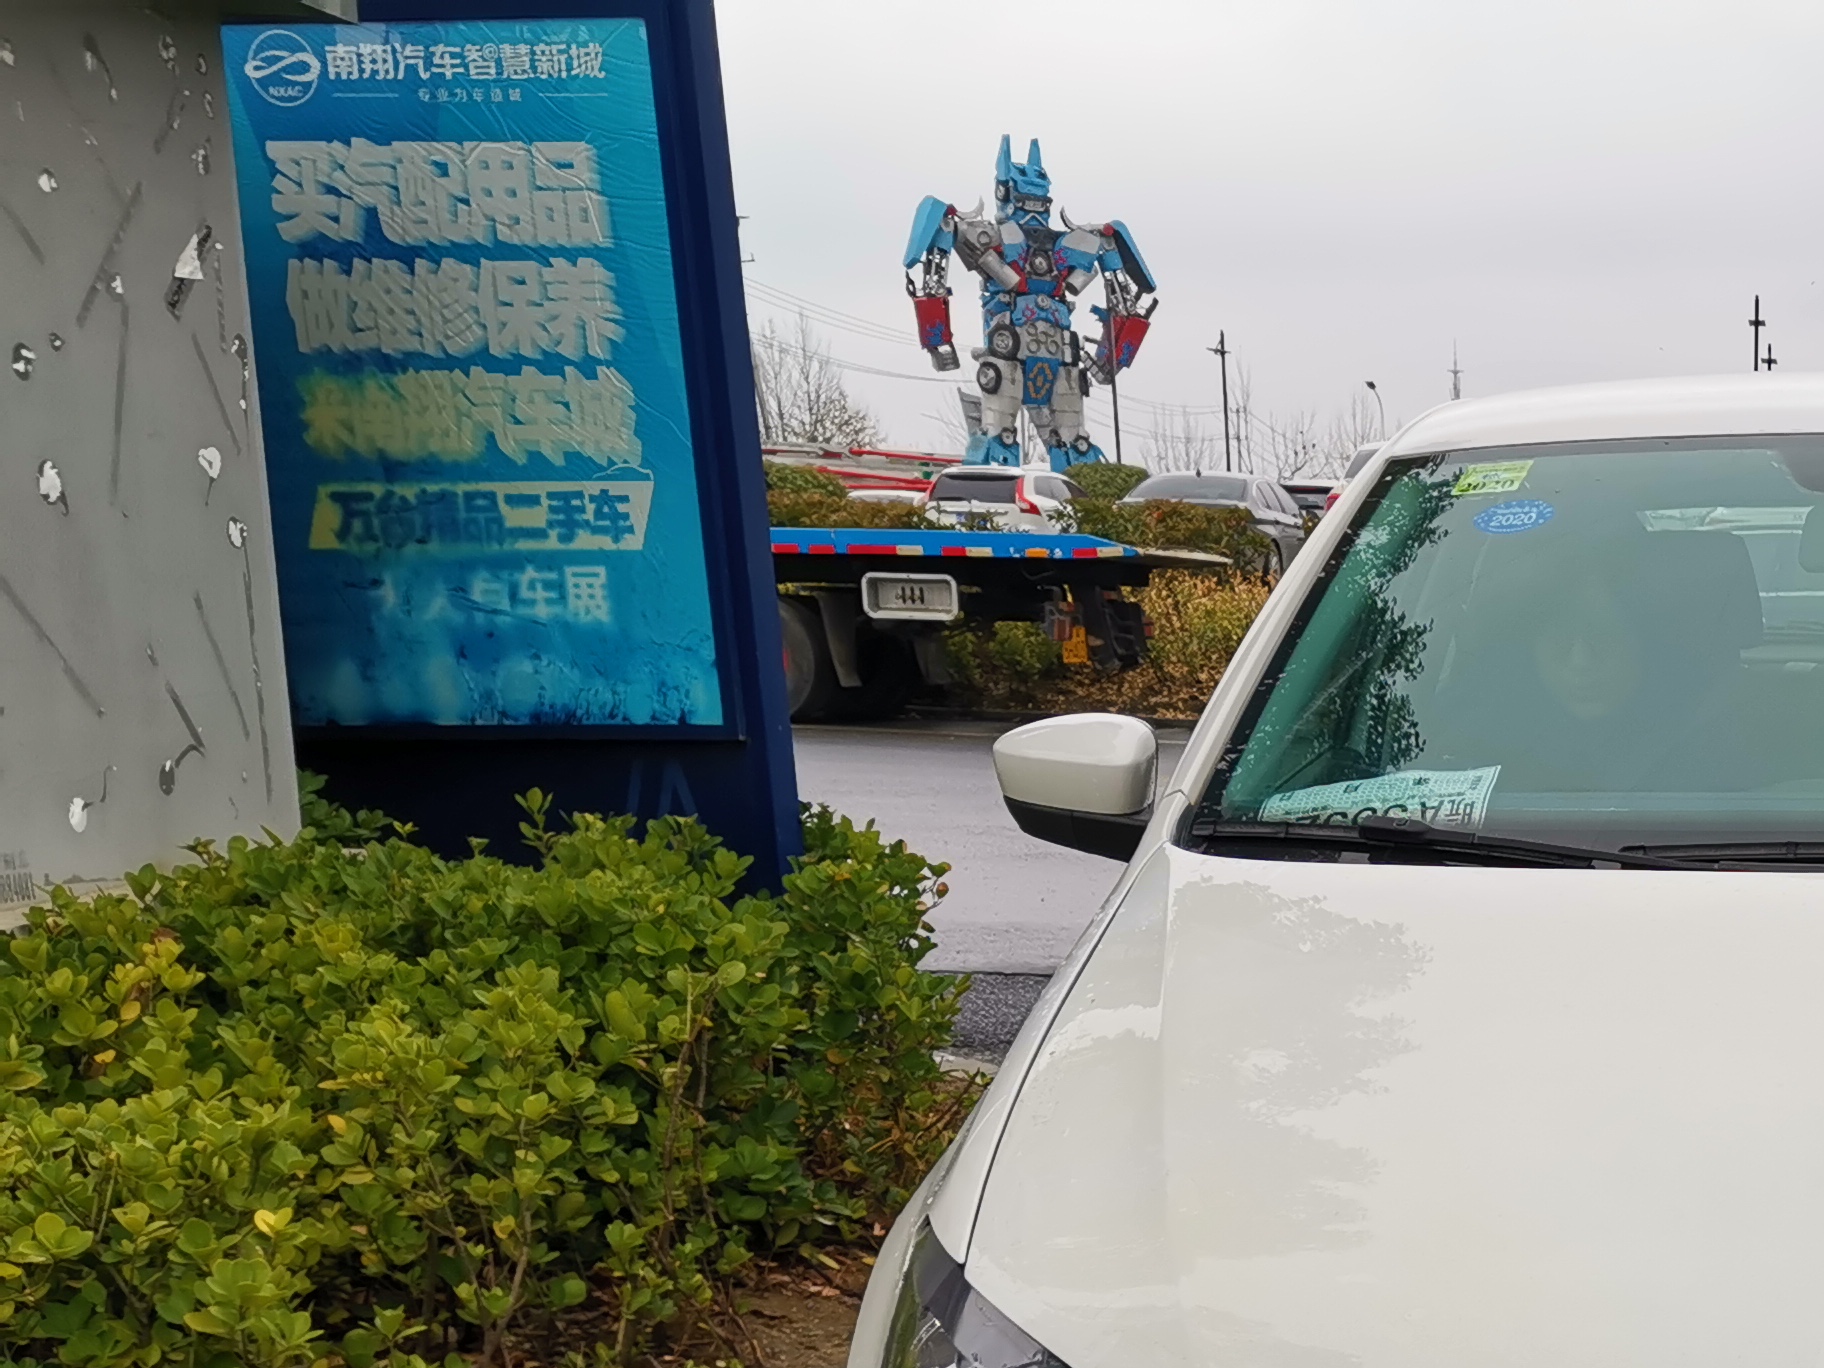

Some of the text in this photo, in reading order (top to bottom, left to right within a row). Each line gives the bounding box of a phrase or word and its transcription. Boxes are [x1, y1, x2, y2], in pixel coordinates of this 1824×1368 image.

[265, 137, 613, 248] 买汽配用品
[286, 257, 627, 361] 做维修保养
[1488, 512, 1537, 526] 2020
